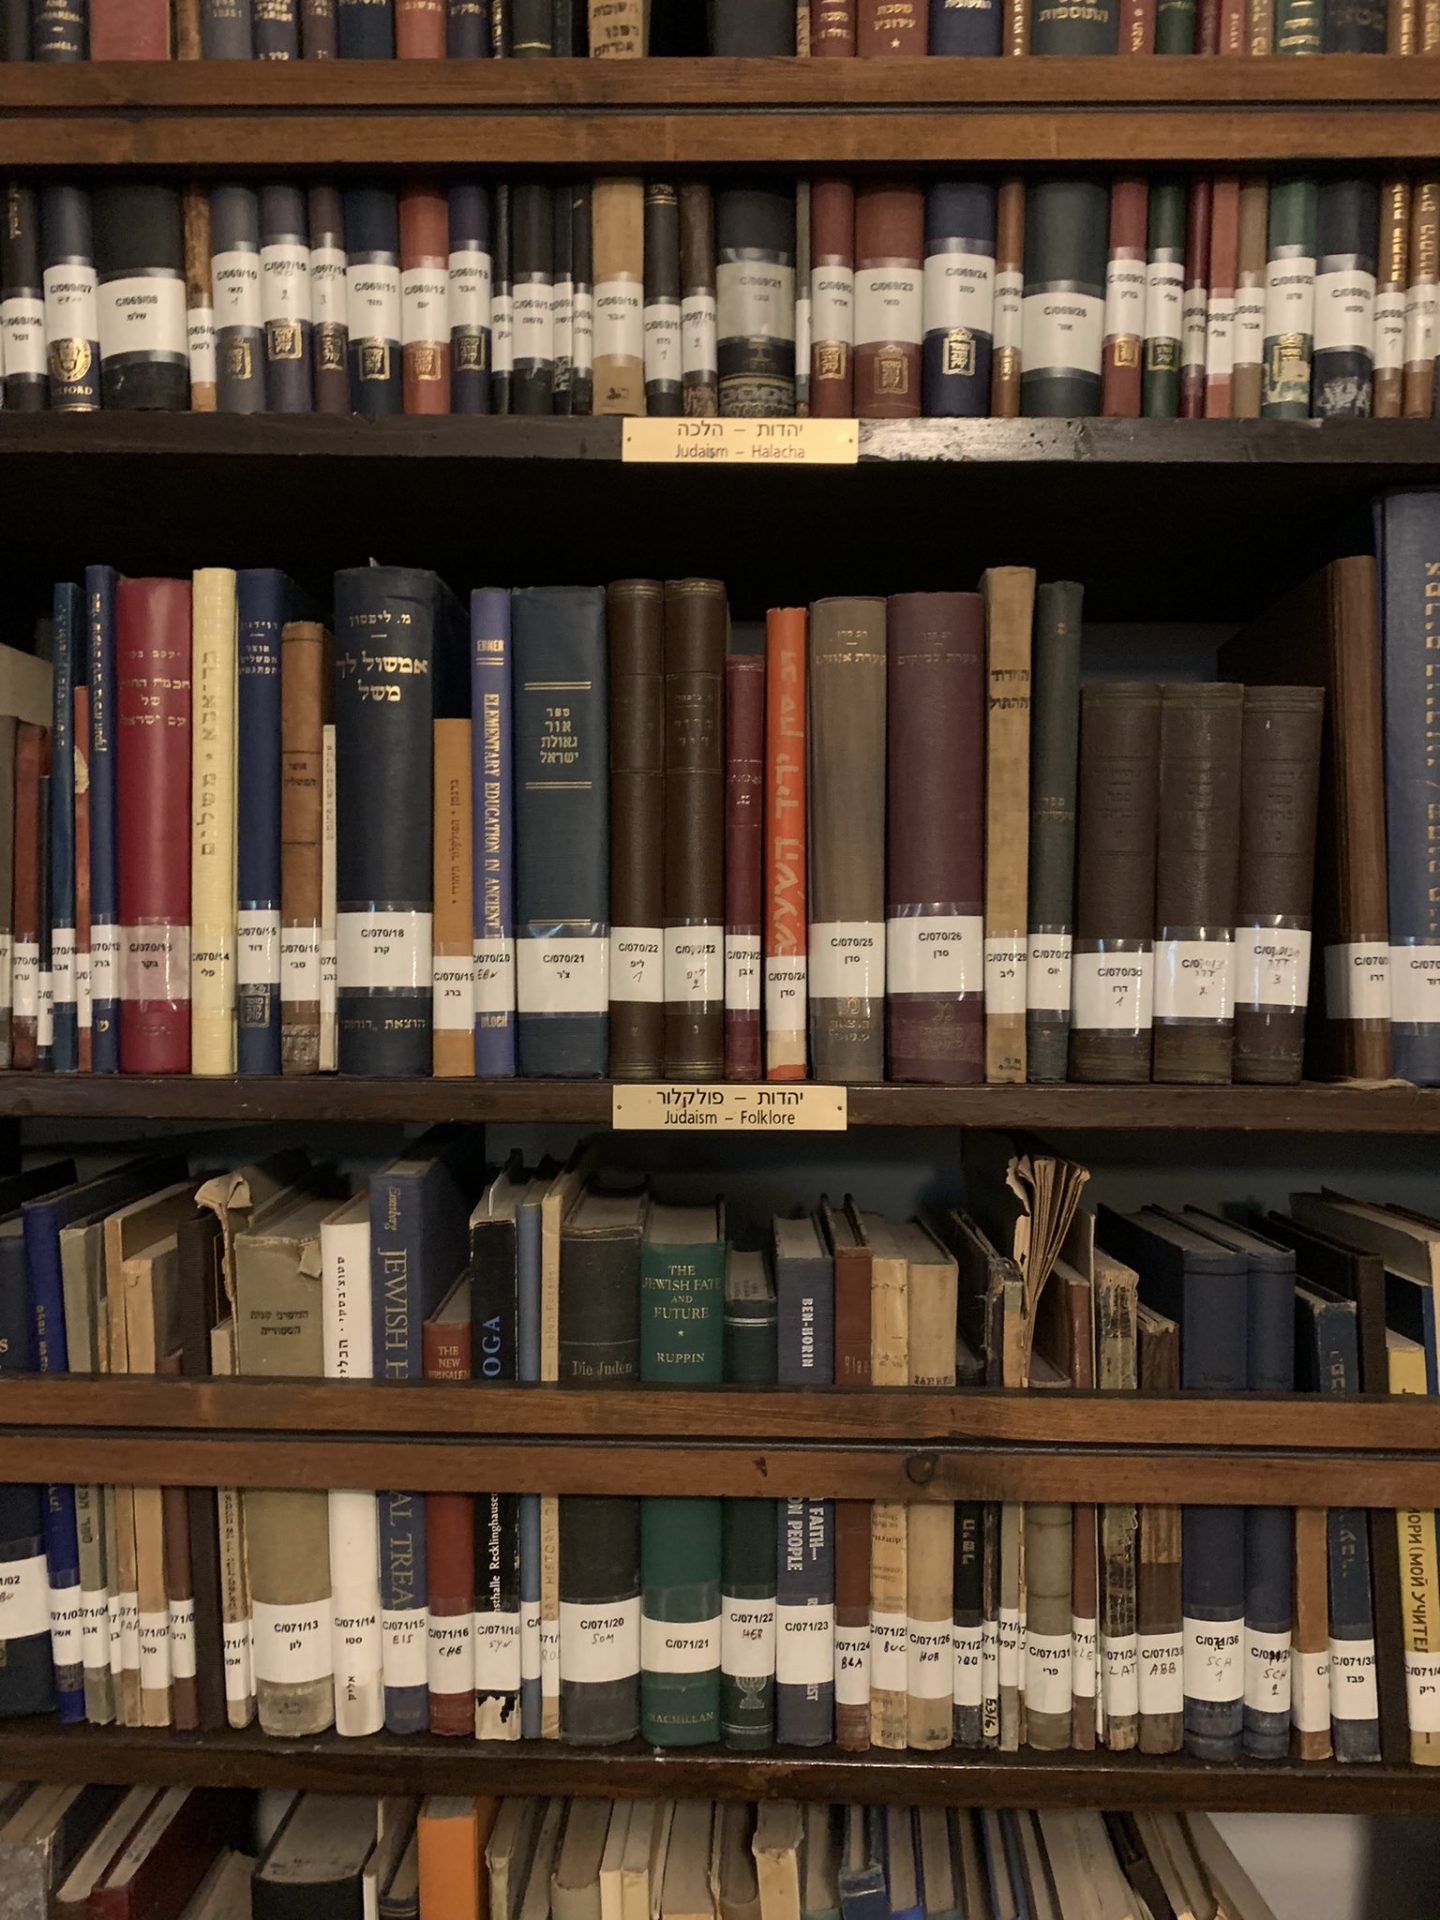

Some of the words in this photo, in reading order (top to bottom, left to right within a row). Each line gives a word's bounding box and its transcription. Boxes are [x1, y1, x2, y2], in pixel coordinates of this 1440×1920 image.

[676, 420, 724, 438] הלכה
[756, 422, 804, 438] יהדות
[674, 443, 729, 460] Judaism
[750, 443, 806, 460] Halacha
[336, 652, 357, 680] לך
[361, 650, 429, 676] אמשול
[357, 678, 402, 703] משל
[546, 706, 571, 718] ספר
[544, 720, 572, 733] אור
[484, 693, 500, 776] ELEMENTARY
[540, 735, 578, 749] גאולת
[539, 750, 580, 765] ישראל
[484, 782, 501, 854] EDUCATION
[484, 859, 500, 872] IN
[360, 928, 405, 938] C/070/18
[918, 931, 963, 943] C/070/26
[618, 943, 659, 953] C/070/22
[830, 937, 874, 948] C/070/25
[542, 954, 585, 963] C/070/21
[844, 953, 861, 965] סדן
[933, 948, 949, 959] סדן
[780, 989, 796, 999] סדן
[656, 1088, 725, 1109] פולקלור
[757, 1091, 804, 1106] יהדות
[664, 1110, 718, 1126] Judaism
[740, 1109, 796, 1126] Folklore
[667, 1264, 696, 1276] THE
[643, 1277, 690, 1291] JEWISH
[693, 1278, 721, 1291] FATE
[377, 1248, 409, 1350] JEWISH
[671, 1294, 694, 1304] AND
[653, 1306, 710, 1320] FUTURE
[801, 1298, 814, 1368] BEN-HORIN
[437, 1345, 459, 1357] THE
[438, 1357, 461, 1368] NEW
[656, 1352, 705, 1364] RUPPIN
[786, 1519, 804, 1572] PEOPLE
[390, 1533, 416, 1610] TREA
[334, 1616, 376, 1628] C/071/14
[580, 1617, 625, 1630] C/071/20
[730, 1612, 774, 1624] C/071/22
[273, 1620, 319, 1633] C/071/13
[382, 1620, 425, 1631] C/071/15
[784, 1622, 829, 1632] C/071/23
[428, 1627, 470, 1639] C/071/16
[909, 1633, 951, 1644] C/071/26
[665, 1638, 710, 1649] C/071/21
[1029, 1646, 1071, 1659] C/071/31
